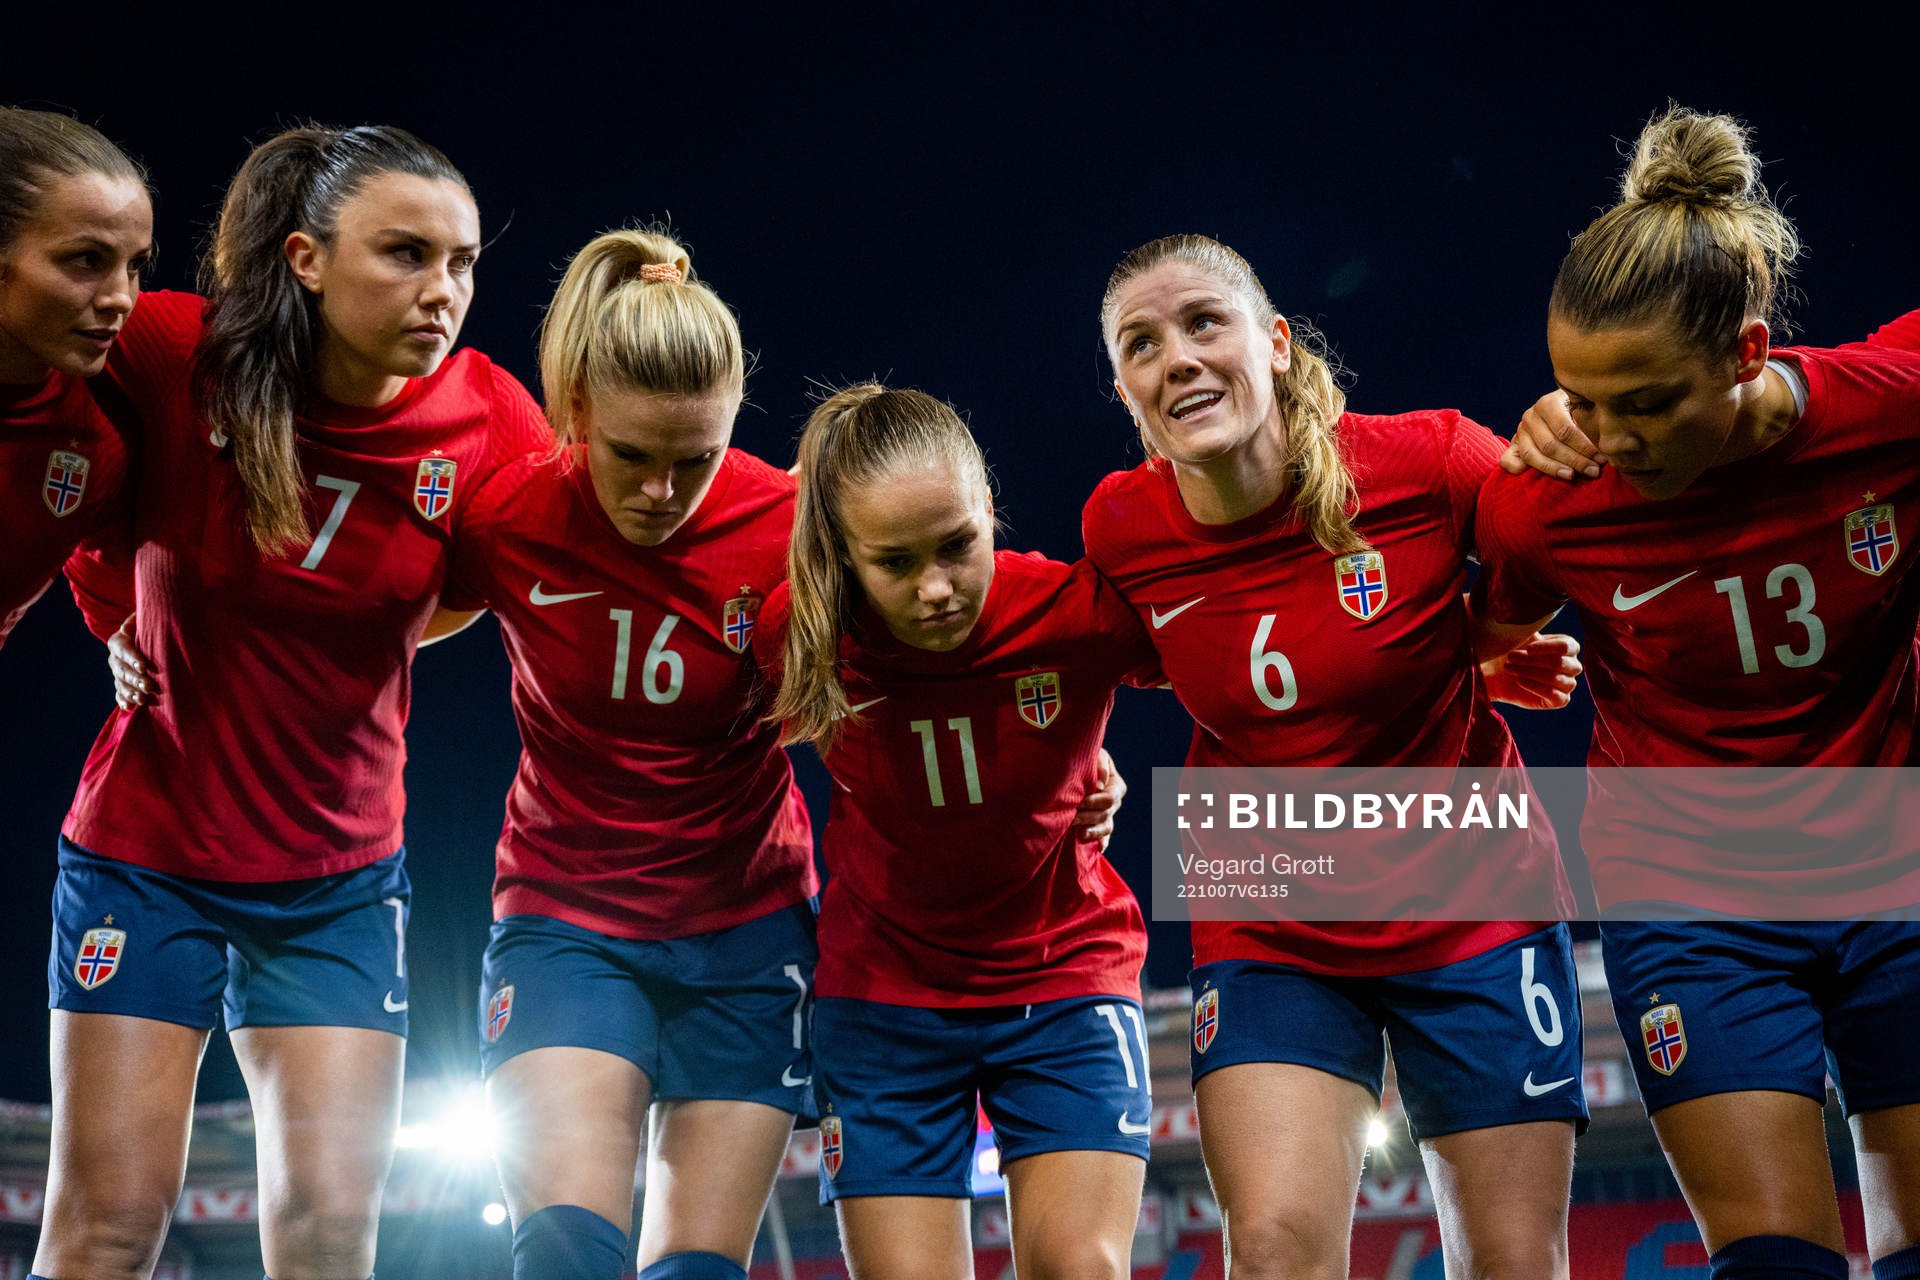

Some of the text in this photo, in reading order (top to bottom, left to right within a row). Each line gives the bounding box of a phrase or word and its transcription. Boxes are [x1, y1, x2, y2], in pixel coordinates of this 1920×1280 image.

[300, 474, 360, 571] 7
[609, 608, 684, 704] 16
[1250, 613, 1298, 711] 6
[1714, 563, 1827, 674] 13
[910, 716, 984, 806] 11
[1520, 947, 1564, 1047] 6
[1094, 1004, 1152, 1096] 11
